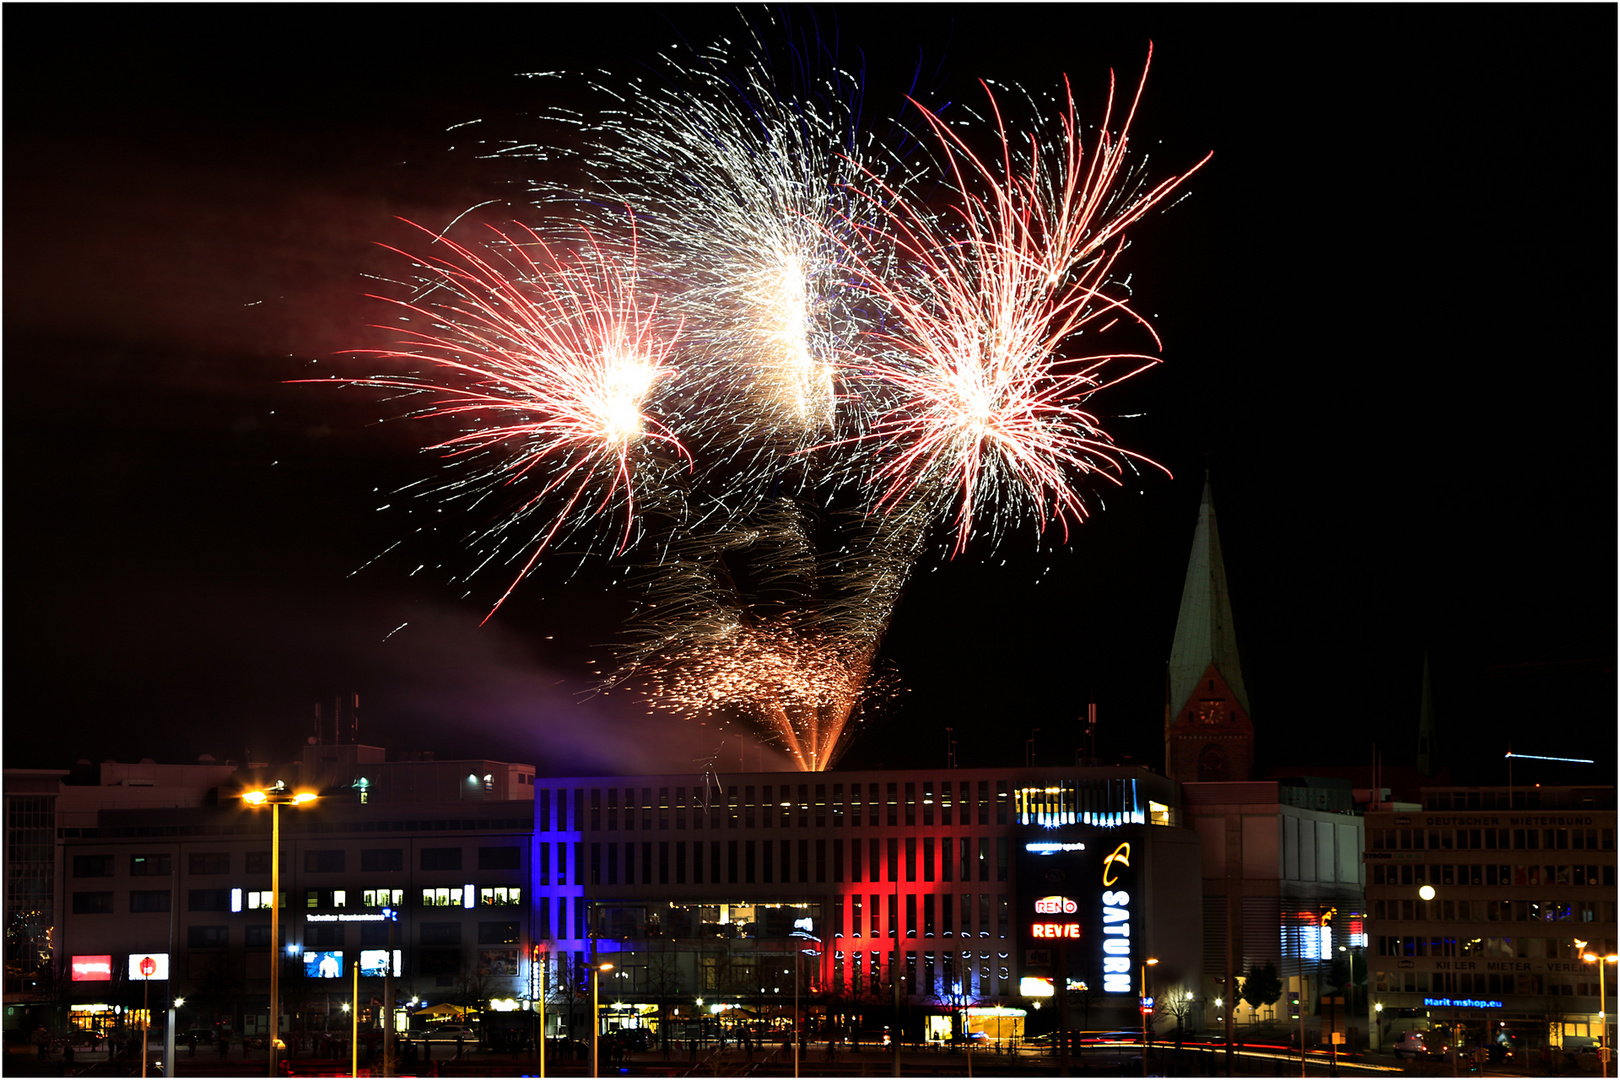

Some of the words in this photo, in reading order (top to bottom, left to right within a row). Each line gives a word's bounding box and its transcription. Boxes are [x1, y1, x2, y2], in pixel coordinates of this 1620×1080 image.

[1426, 817, 1499, 826] DEUTSCHER
[1510, 817, 1593, 826] MIETERBUND
[1037, 901, 1076, 913] RENO
[1033, 924, 1080, 937] REWE
[1102, 890, 1131, 992] SATURN
[1436, 961, 1476, 970] KIELER
[1488, 962, 1531, 971] MIETER
[1424, 997, 1503, 1009] Maritmshop.eu
